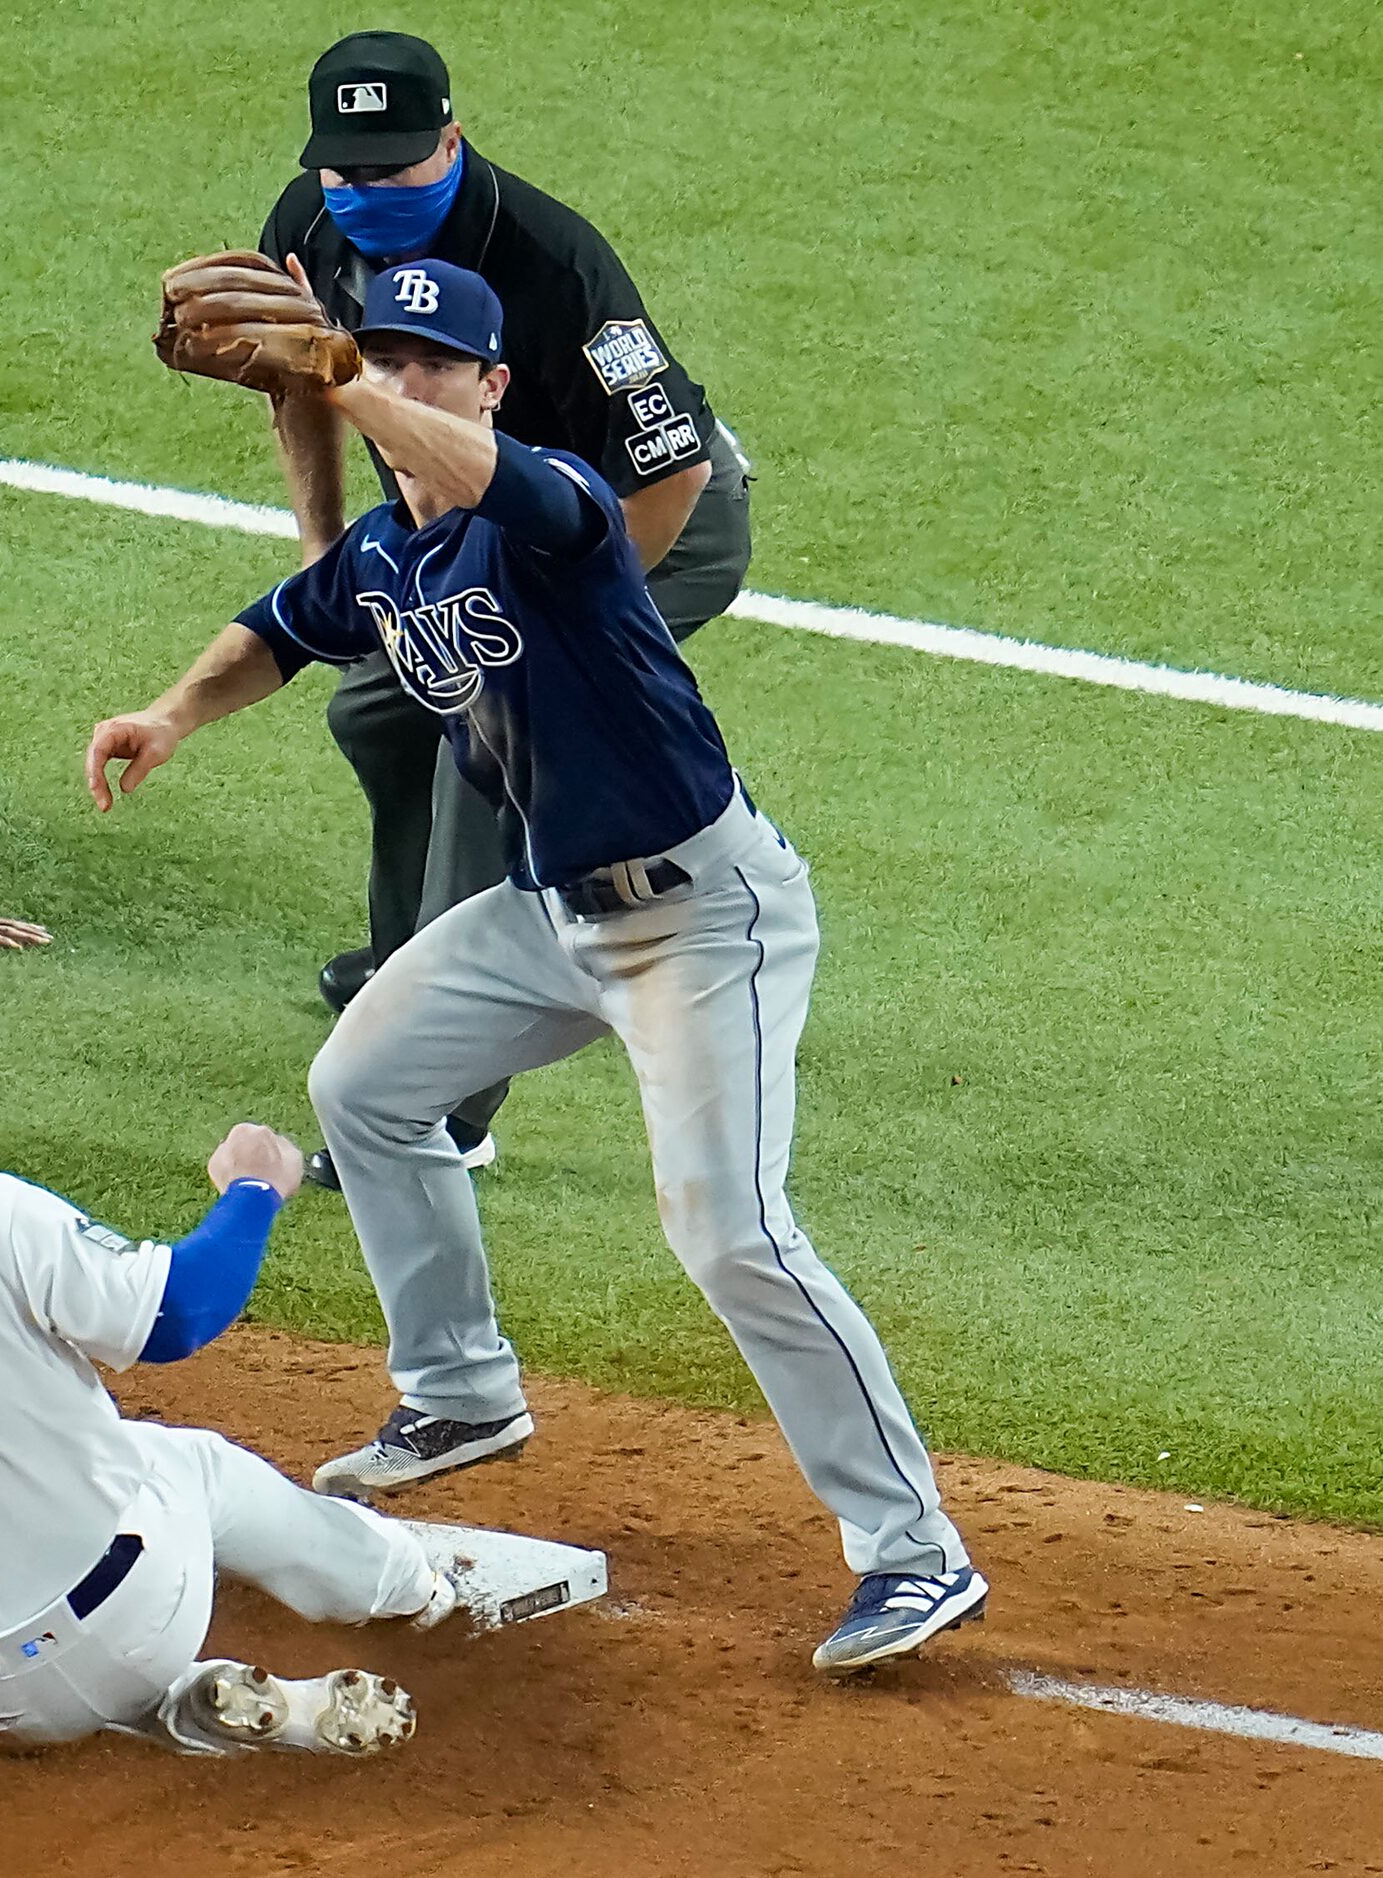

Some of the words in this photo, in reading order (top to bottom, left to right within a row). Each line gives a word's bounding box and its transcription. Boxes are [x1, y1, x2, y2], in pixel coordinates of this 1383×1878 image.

[393, 269, 440, 314] TB
[591, 327, 649, 367] WORLD
[602, 344, 660, 386] SERIES
[634, 394, 667, 422] EC
[634, 436, 668, 463] CM
[667, 424, 695, 450] RR
[355, 587, 524, 714] RAYS
